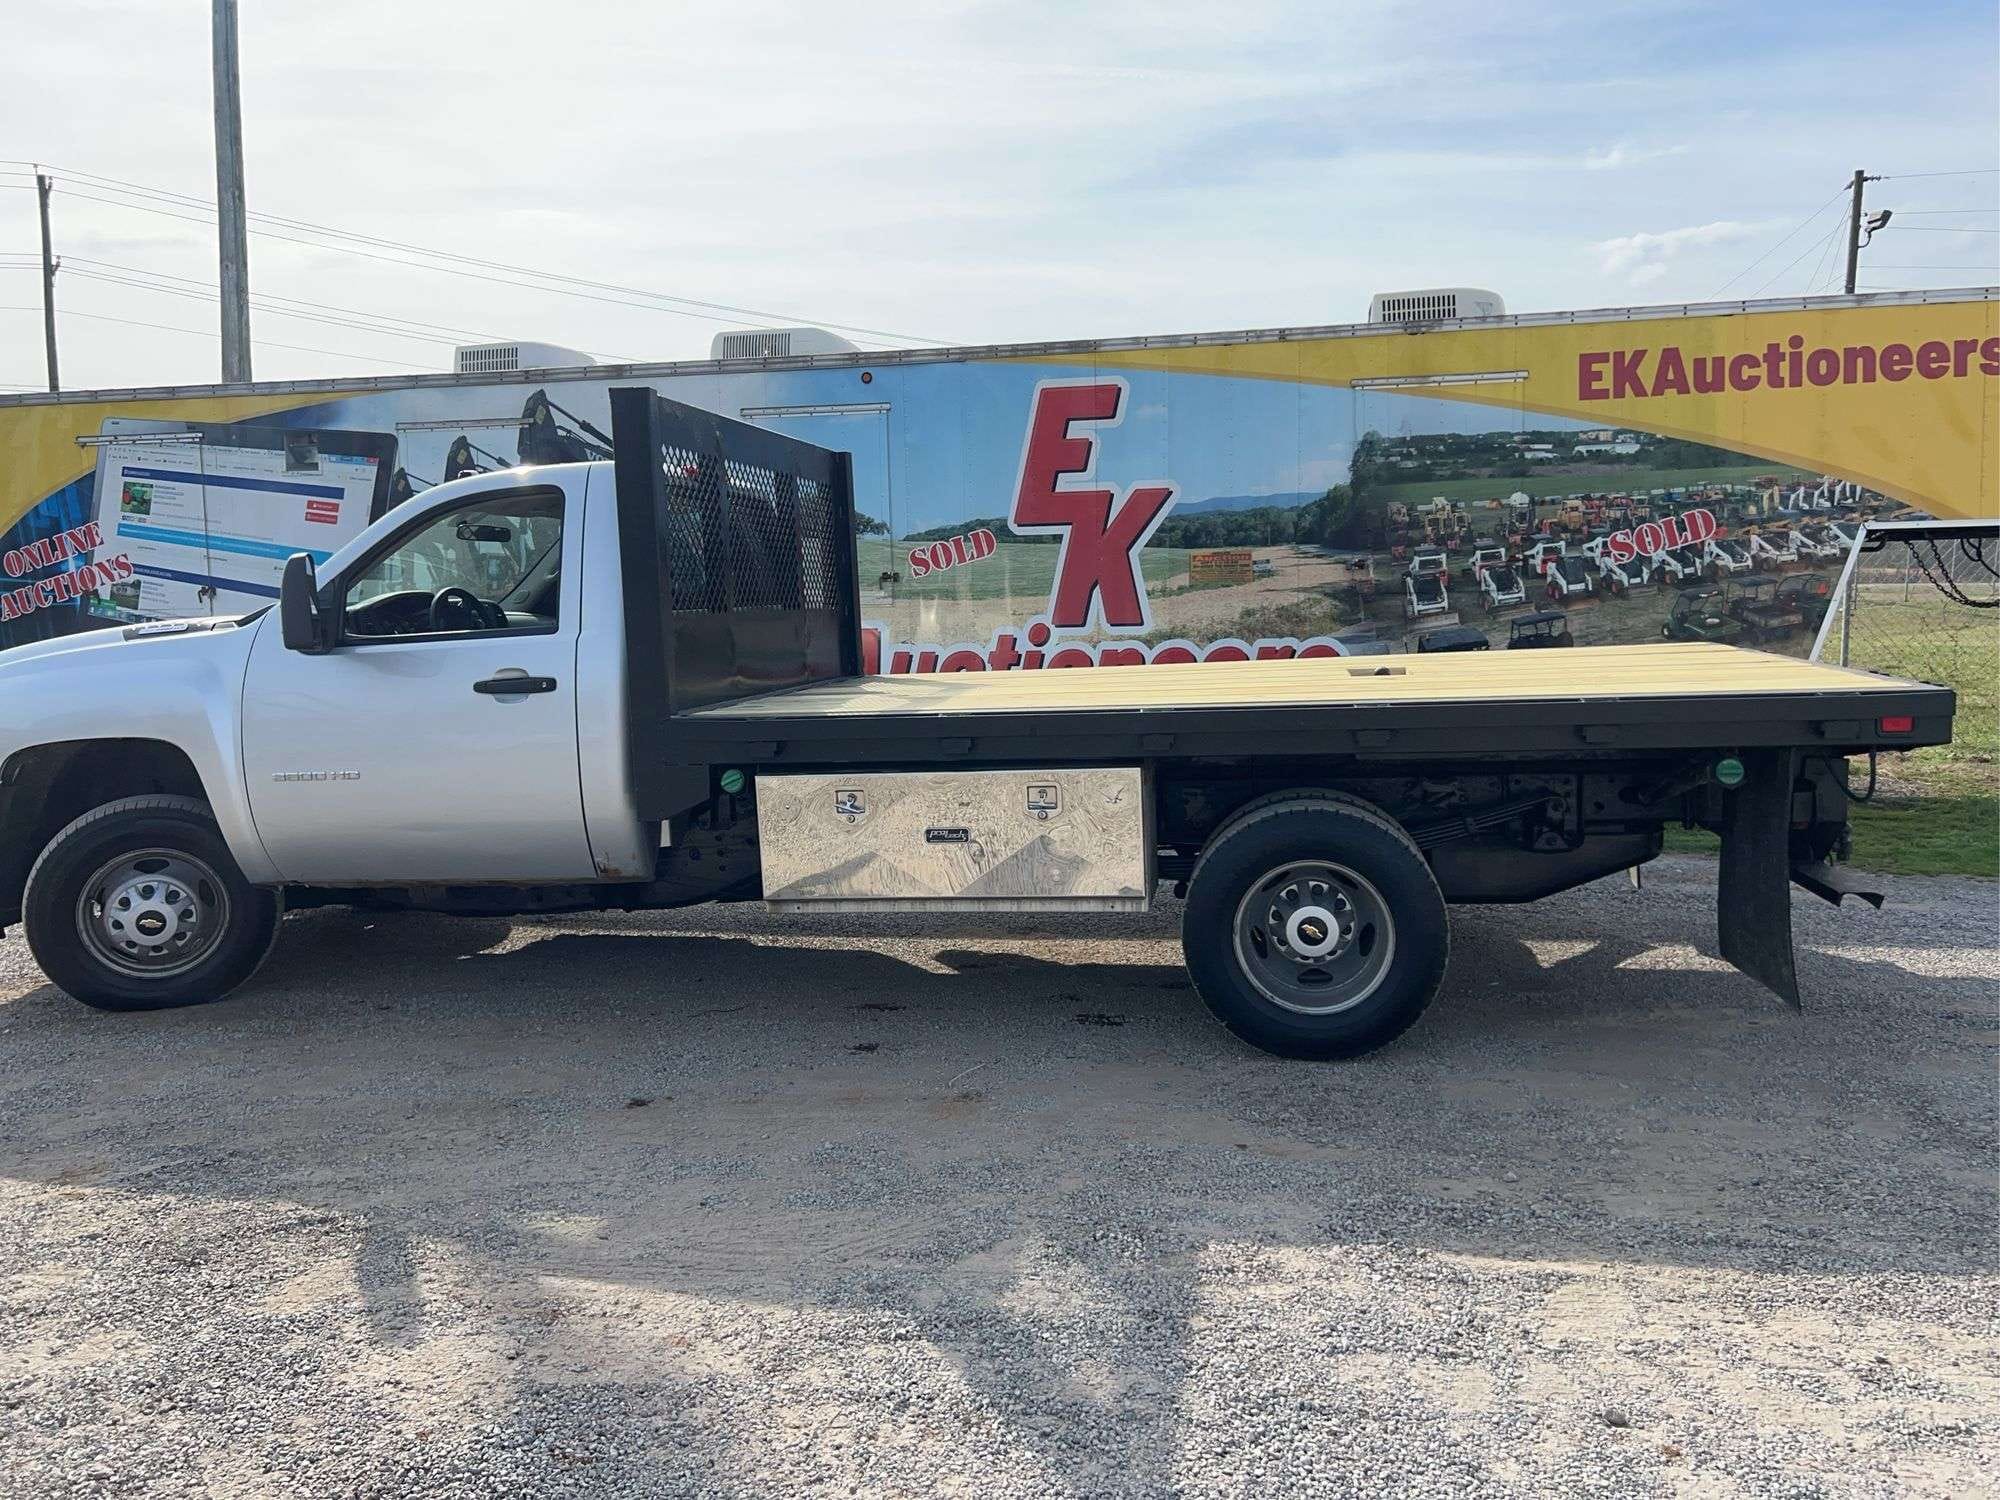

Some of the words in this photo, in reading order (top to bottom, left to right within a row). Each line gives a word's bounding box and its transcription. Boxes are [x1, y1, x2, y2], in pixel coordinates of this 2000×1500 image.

[1578, 335, 2000, 400] EKAuctioneers
[3, 520, 105, 577] ONLINE
[908, 529, 997, 578] SOLD
[1607, 509, 1716, 564] SOLD
[0, 553, 133, 622] AUCTIONS
